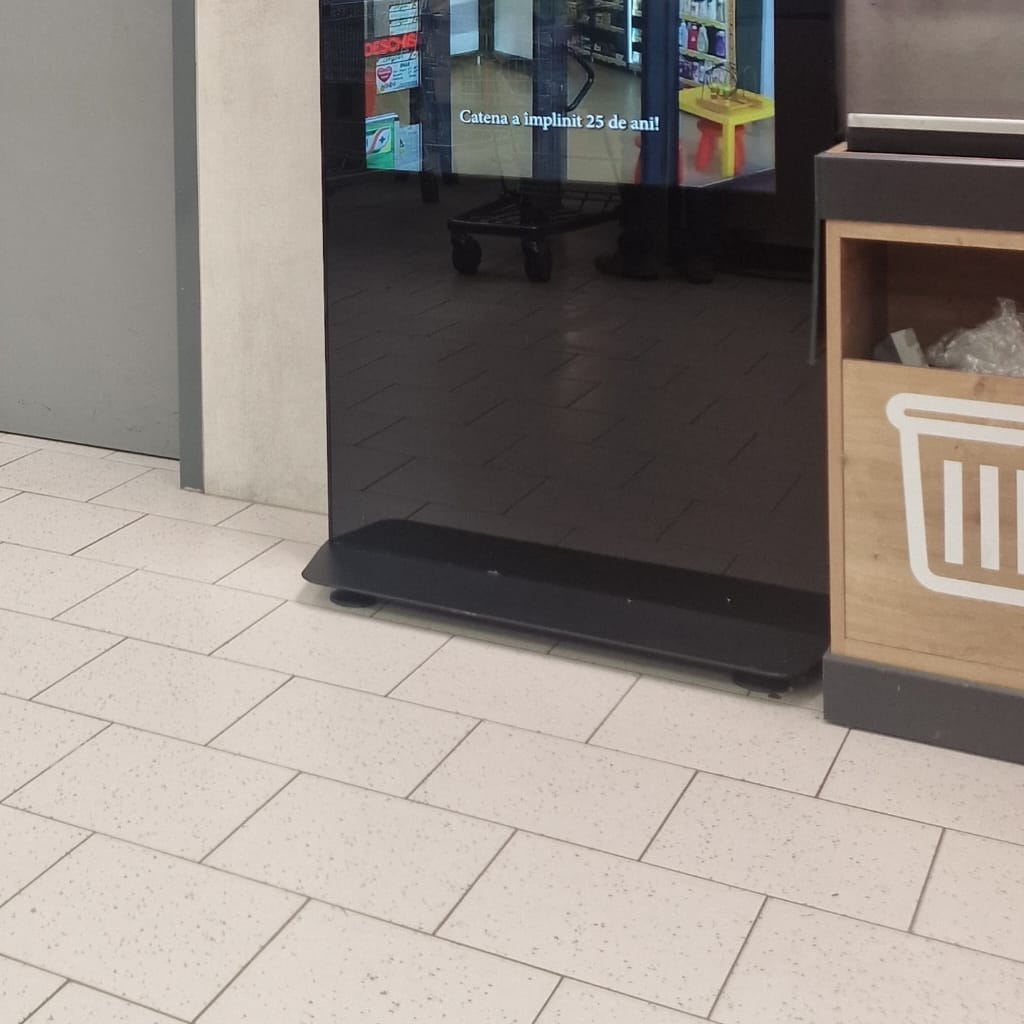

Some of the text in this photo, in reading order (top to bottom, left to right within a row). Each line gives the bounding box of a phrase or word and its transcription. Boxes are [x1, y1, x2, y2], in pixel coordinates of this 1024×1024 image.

[459, 109, 660, 132] Catena a împlinit 25 de ani!
